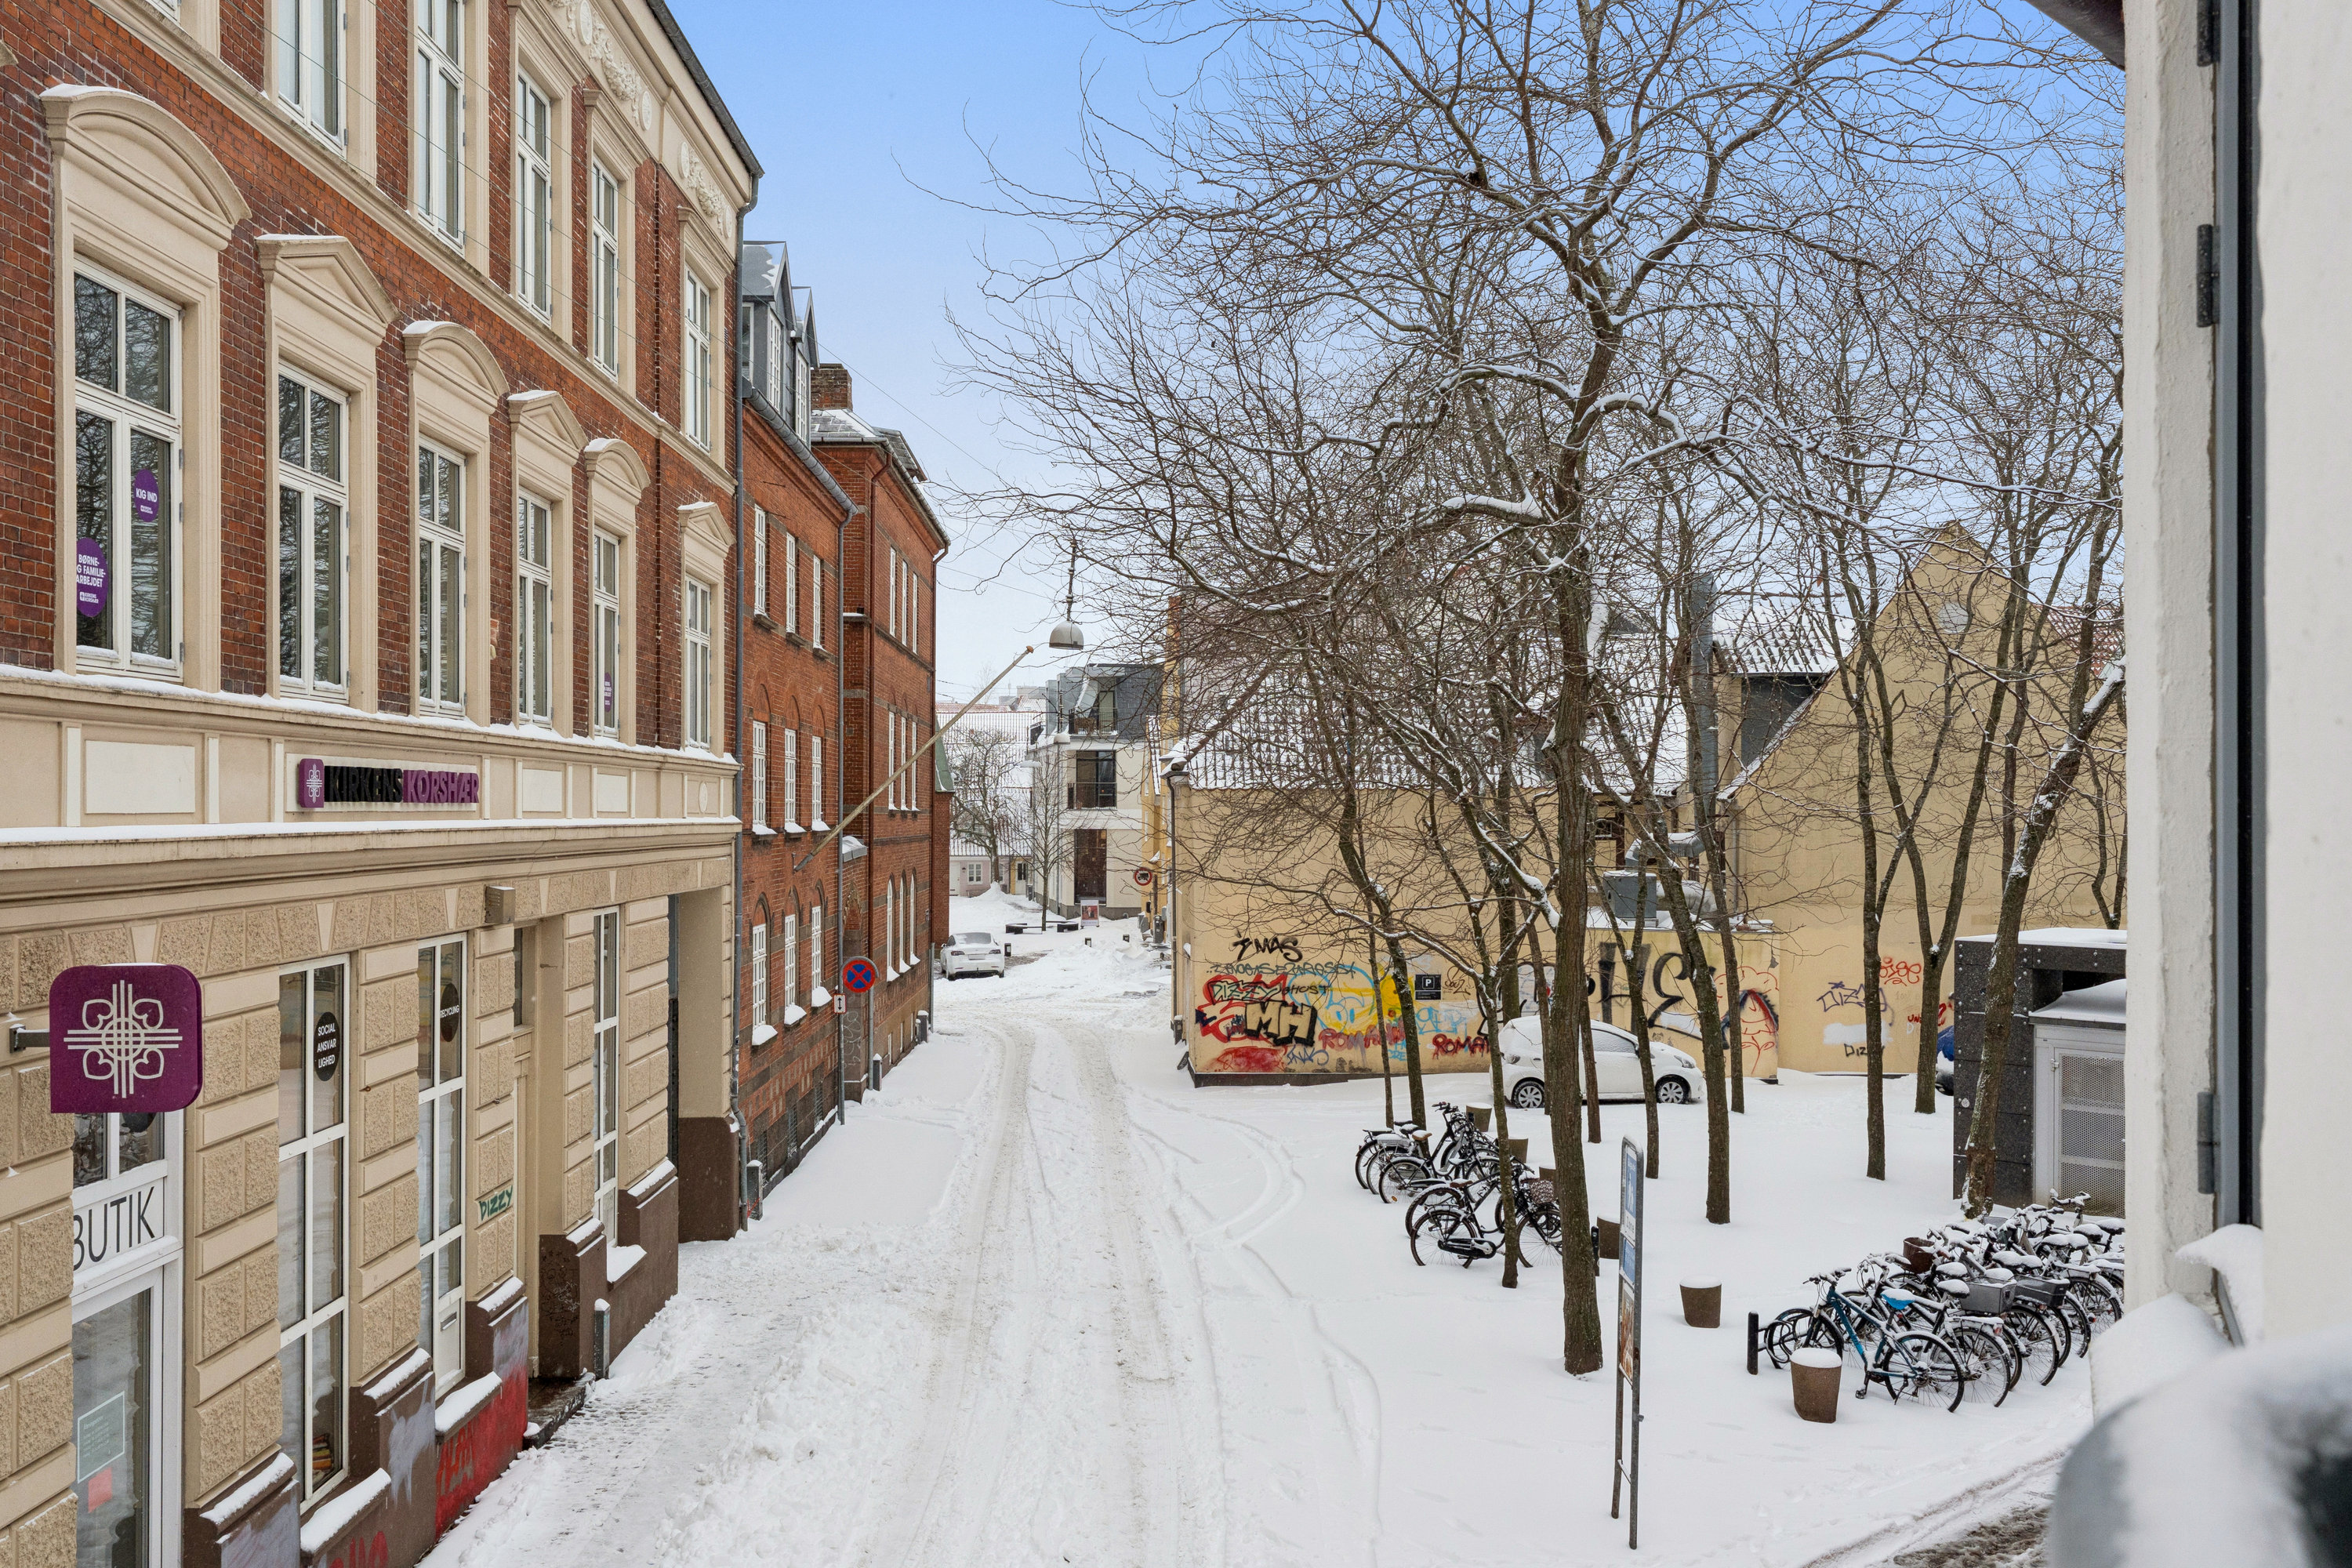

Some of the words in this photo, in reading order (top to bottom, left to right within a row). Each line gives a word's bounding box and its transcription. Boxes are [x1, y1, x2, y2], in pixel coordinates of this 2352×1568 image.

[136, 487, 147, 499] KIG
[147, 491, 158, 503] IND
[78, 554, 100, 567] BØRNE-
[83, 565, 106, 578] FAMILIE-
[76, 574, 103, 588] ARBEJDET
[325, 765, 403, 803] KIRKENS
[403, 769, 480, 804] KORSHÆR
[318, 1022, 336, 1036] SOCIAL
[317, 1038, 337, 1053] ANSVAR
[318, 1054, 336, 1069] LIGHED
[479, 1185, 514, 1221] DIZZY
[73, 1186, 155, 1271] BUTIK
